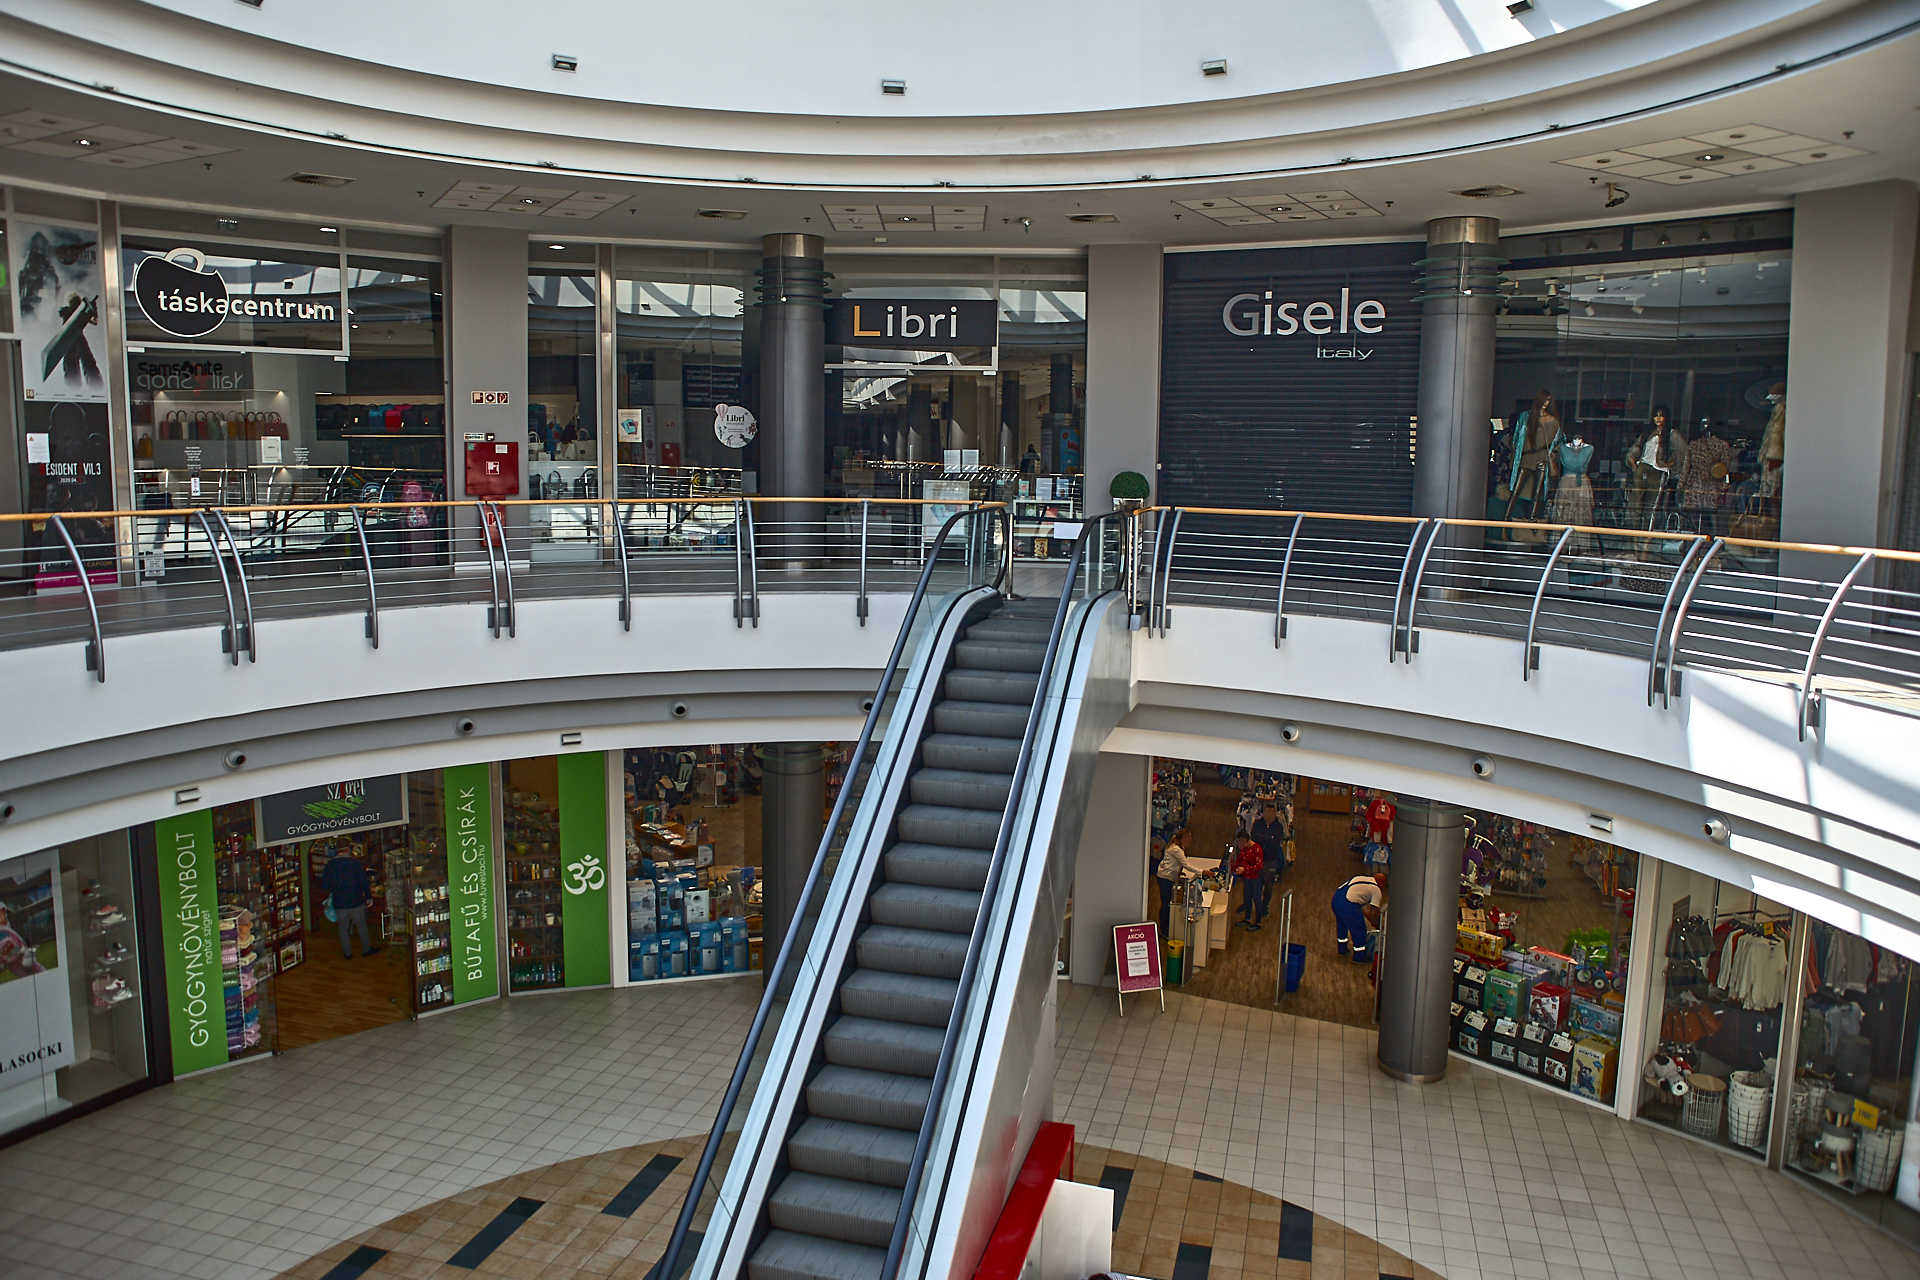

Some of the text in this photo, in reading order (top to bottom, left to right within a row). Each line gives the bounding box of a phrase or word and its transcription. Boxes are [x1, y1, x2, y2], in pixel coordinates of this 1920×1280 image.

[158, 289, 335, 321] táskacentrum
[853, 304, 957, 338] Libri
[1222, 287, 1386, 337] Gisele
[1316, 347, 1374, 361] Italy
[96, 462, 102, 476] 3
[457, 786, 483, 981] BÚZAFŰ ÉS CSÍRÁK
[176, 832, 209, 1048] GYÓGYNÖVÉNYBOLT
[0, 1041, 63, 1073] LASOCKI
